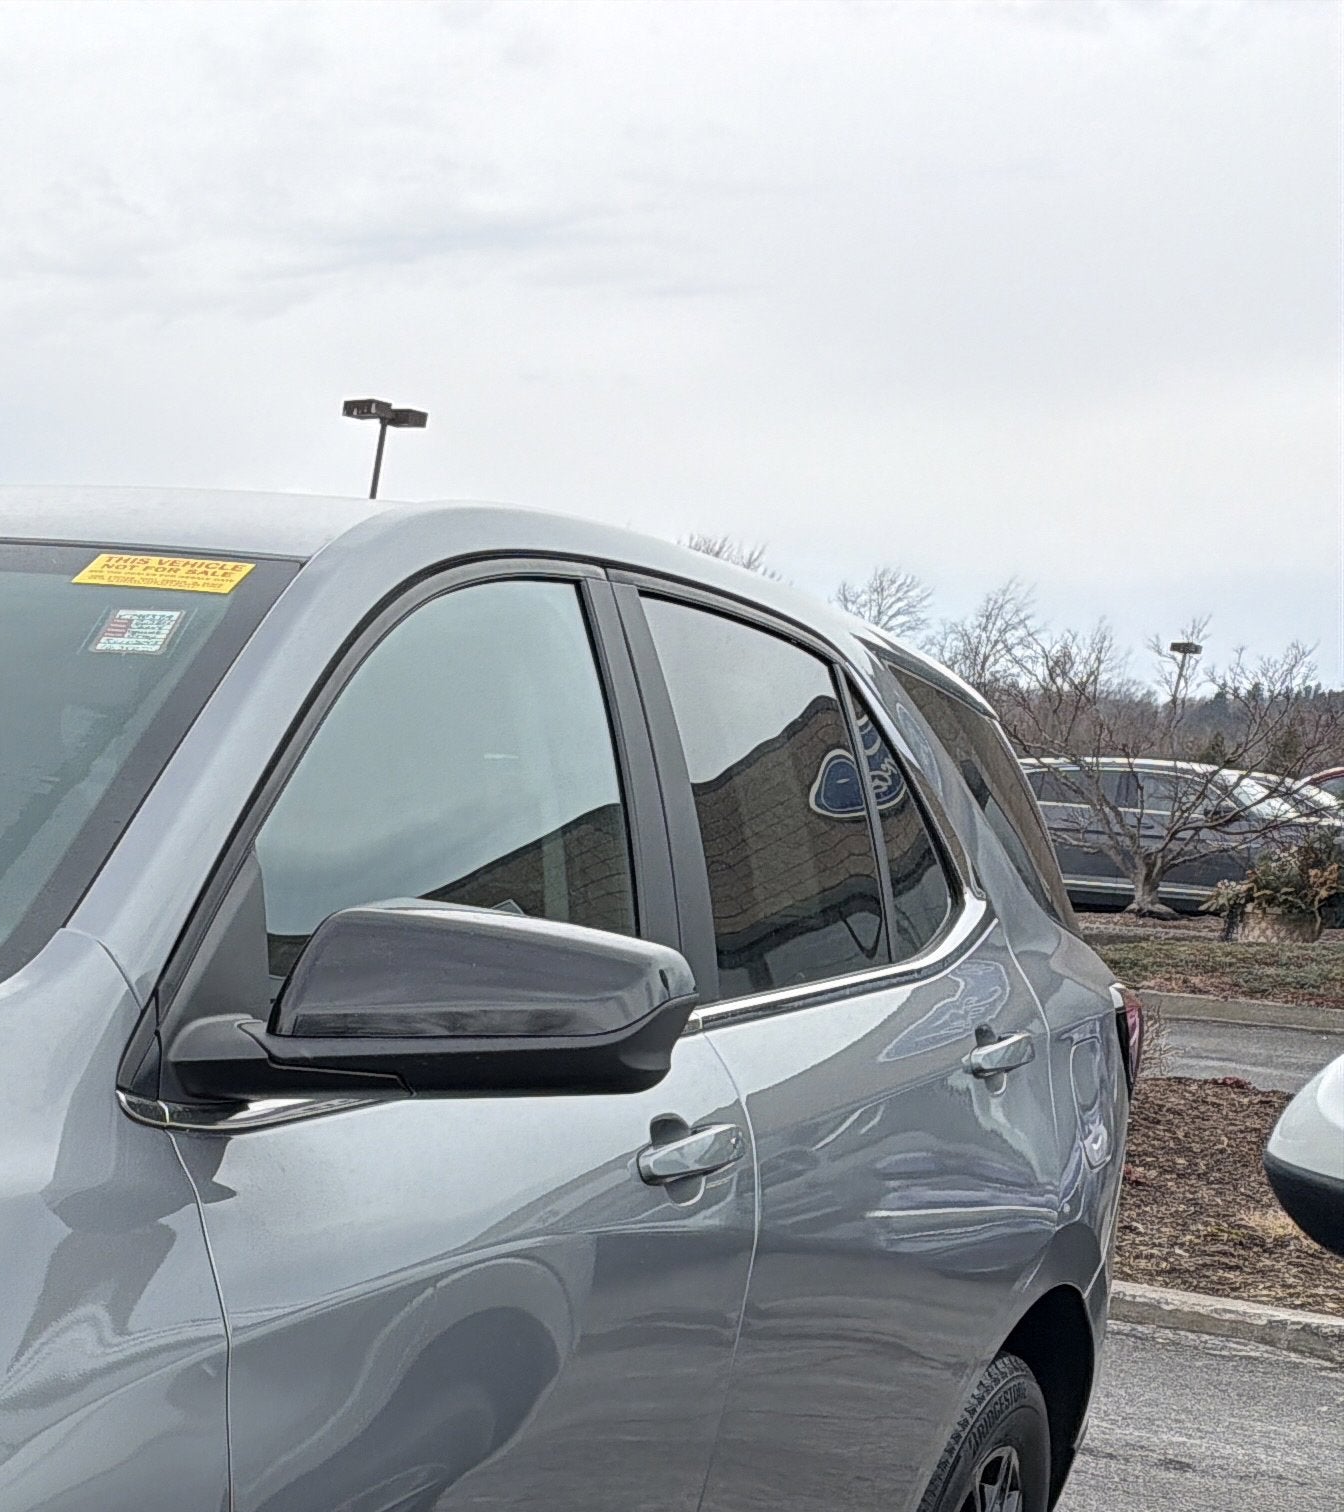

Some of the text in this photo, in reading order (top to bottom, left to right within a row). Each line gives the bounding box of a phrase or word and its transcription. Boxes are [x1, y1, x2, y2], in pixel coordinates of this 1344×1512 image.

[100, 563, 140, 571] NOT
[142, 565, 181, 574] FOR
[184, 569, 236, 578] SALE
[104, 556, 247, 572] THIS VEHICLE
